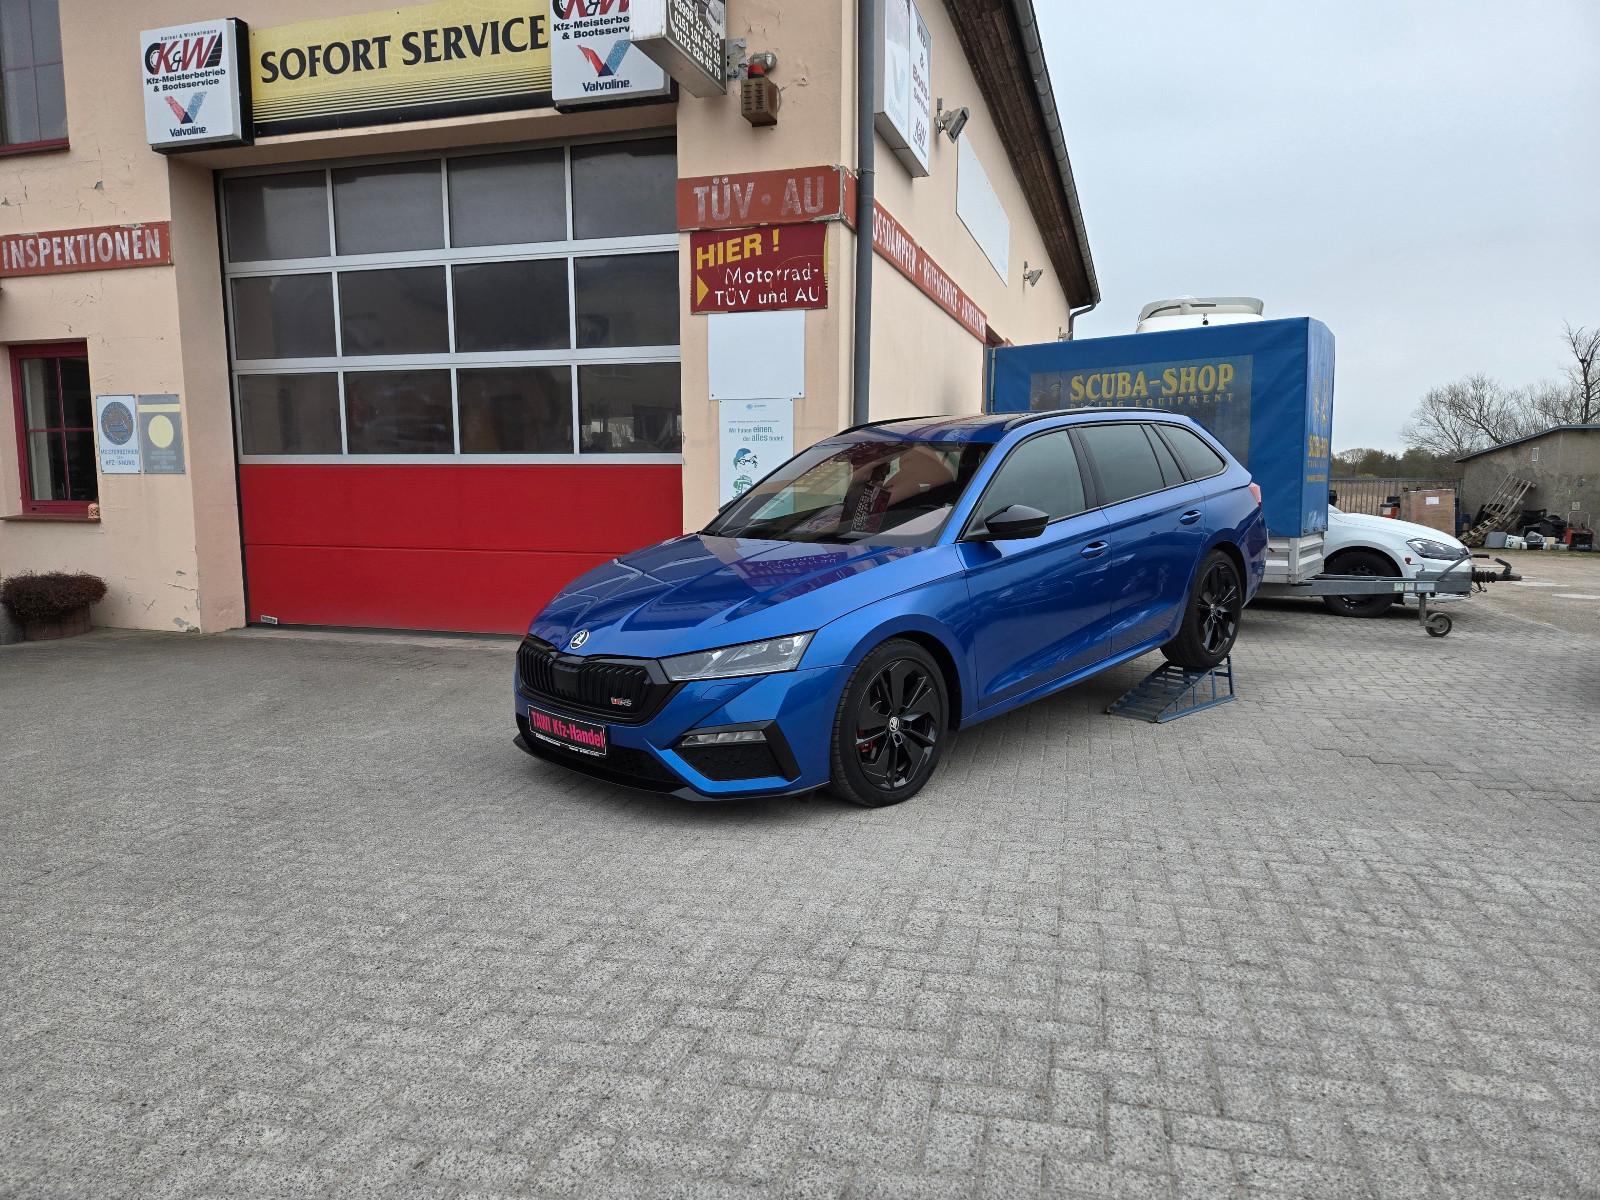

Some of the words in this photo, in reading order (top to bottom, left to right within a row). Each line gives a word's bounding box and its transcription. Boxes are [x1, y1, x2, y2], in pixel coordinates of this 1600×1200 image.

[553, 15, 631, 32] Kfz-Meisterbe
[561, 32, 570, 40] &
[573, 25, 631, 39] Bootsserv
[674, 11, 690, 36] 0151
[401, 15, 549, 66] SERVICE
[675, 27, 692, 53] 0172
[153, 35, 218, 75] K&W
[260, 35, 392, 84] SOFORT
[146, 69, 226, 86] Kfz-Meisterbetrieb
[153, 85, 160, 93] &
[162, 78, 220, 92] Bootsservice
[581, 79, 631, 92] Valvoline
[169, 126, 208, 138] Valvoline
[693, 176, 755, 223] TÜV
[780, 175, 825, 216] AU
[3, 228, 161, 270] INSPEKTIONEN
[696, 233, 762, 270] HIER
[725, 262, 819, 285] Motorrad-
[714, 287, 751, 306] TÜV
[758, 287, 787, 304] und
[795, 286, 821, 302] AU
[1069, 363, 1234, 400] SCUBA-SHOP
[1070, 400, 1124, 409] DIING
[1135, 393, 1234, 408] EQUIPMENT
[751, 433, 768, 441] alles
[553, 718, 604, 748] Kfz-Handel
